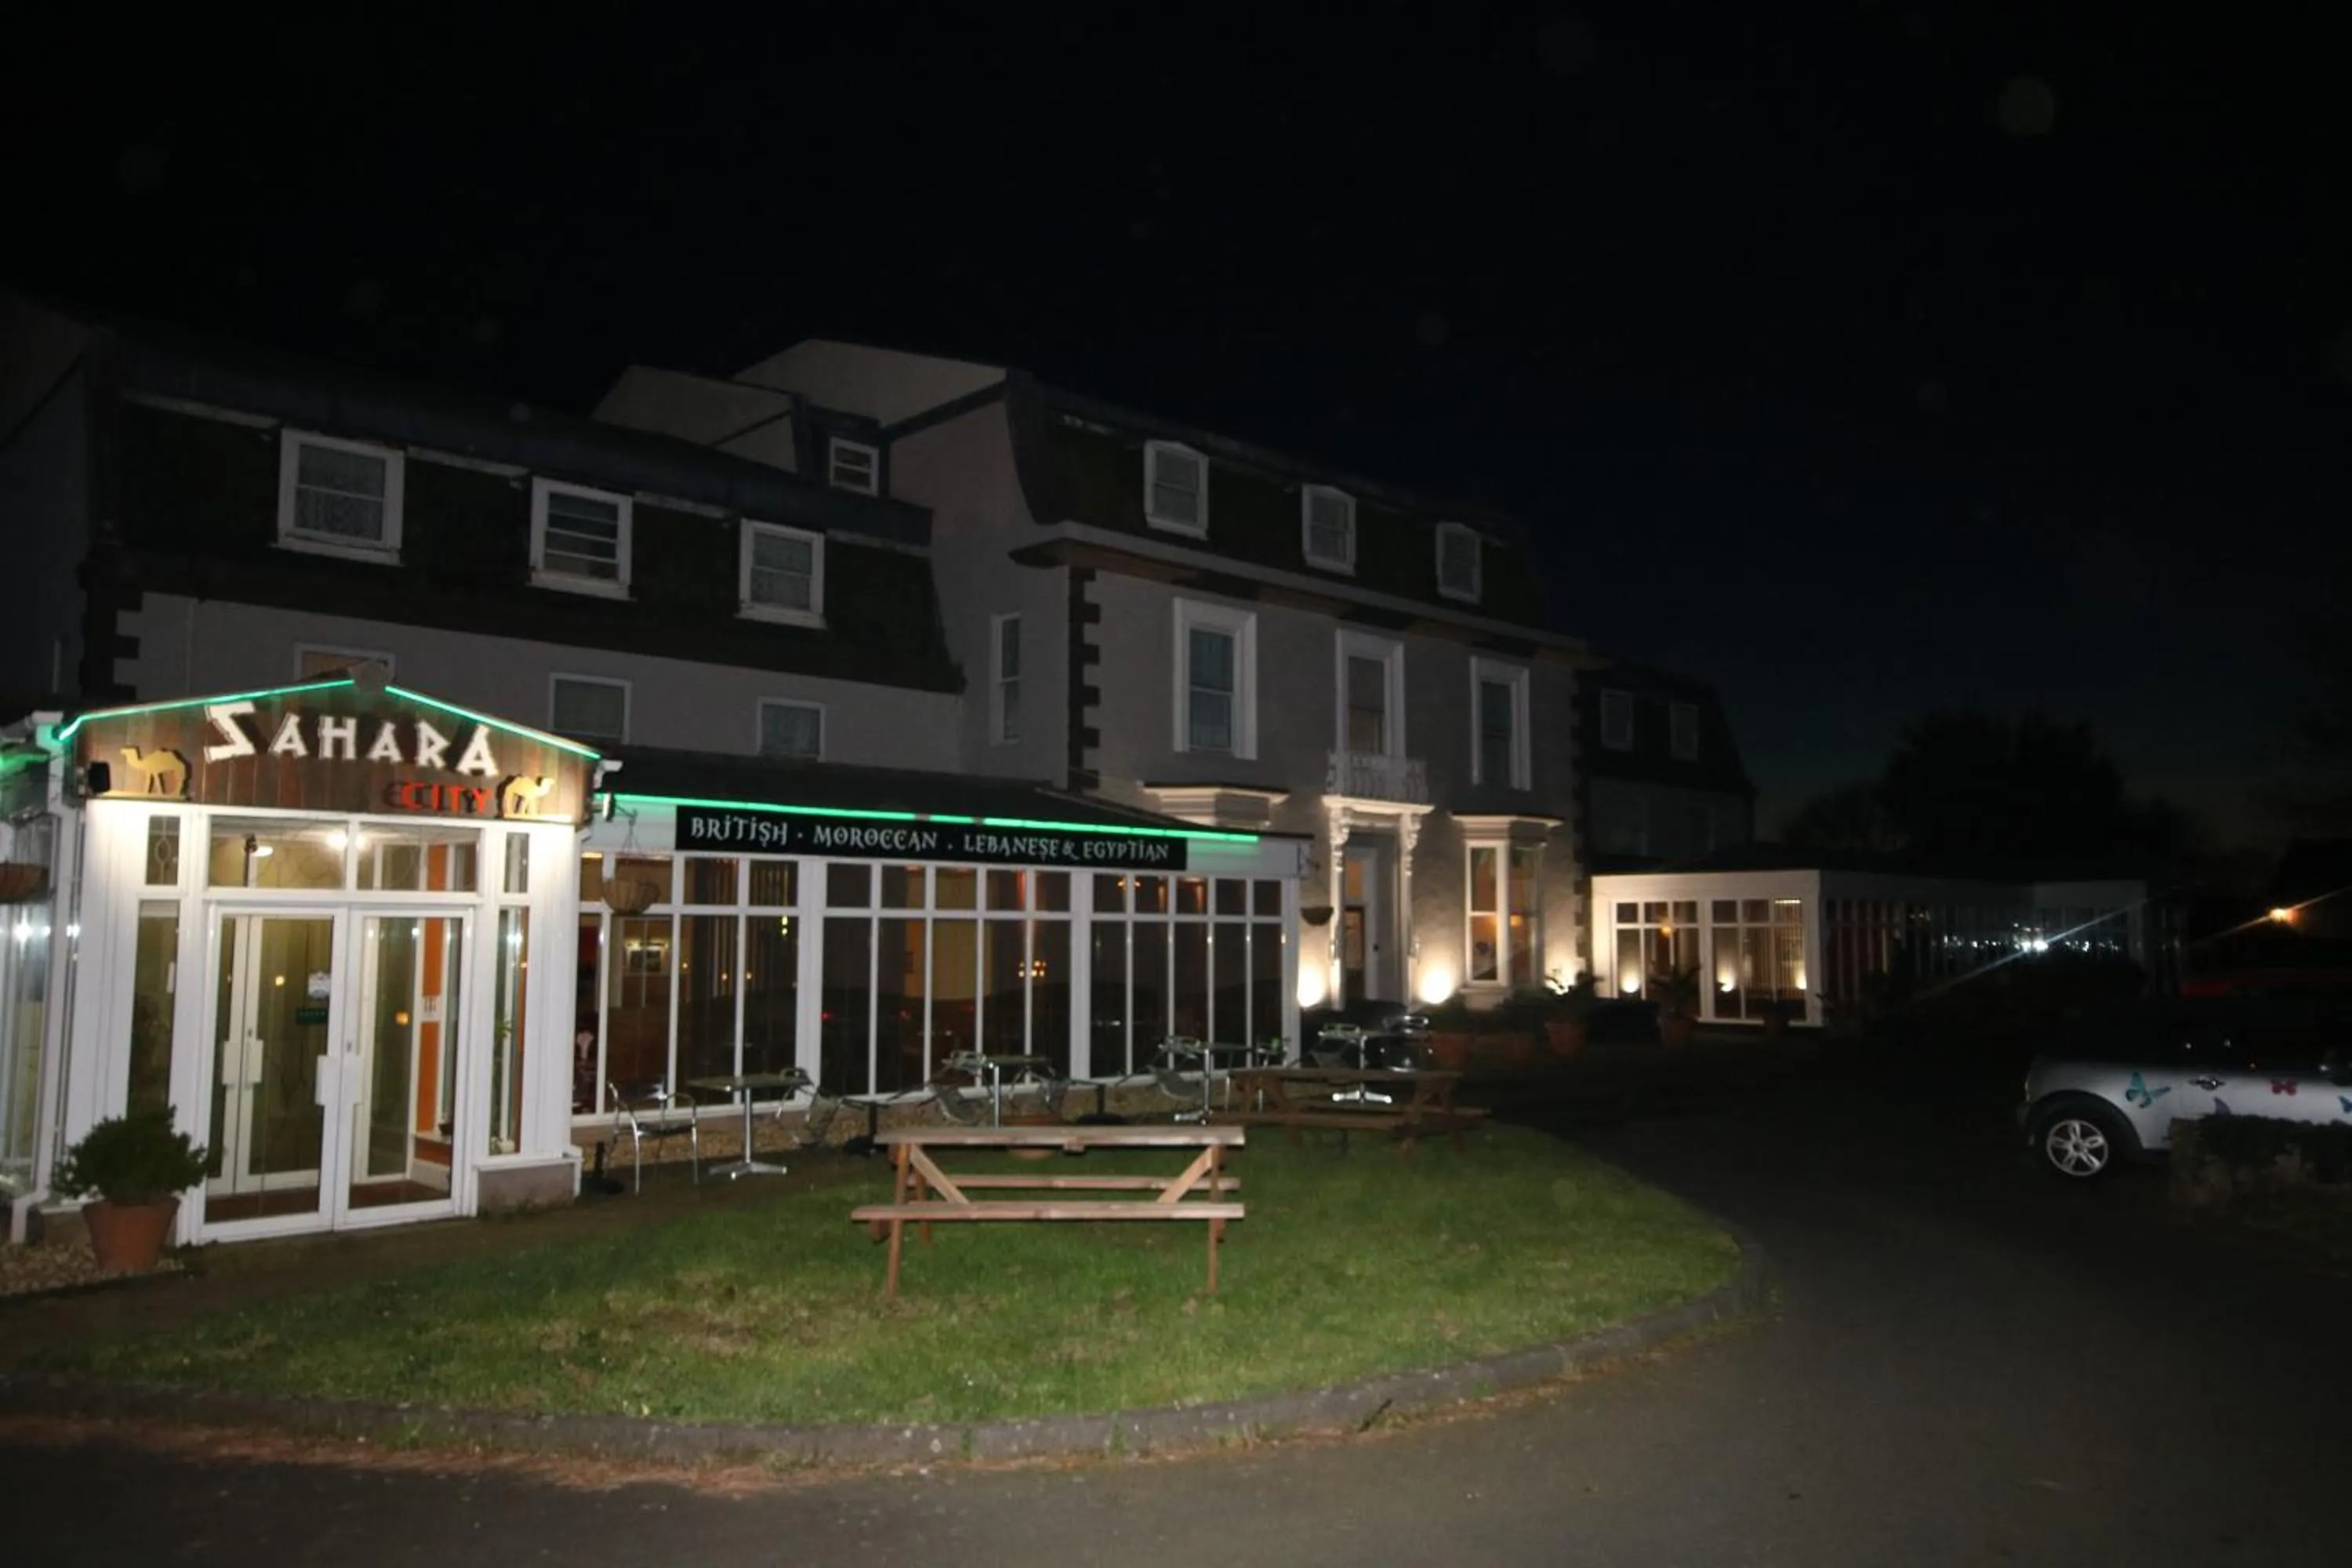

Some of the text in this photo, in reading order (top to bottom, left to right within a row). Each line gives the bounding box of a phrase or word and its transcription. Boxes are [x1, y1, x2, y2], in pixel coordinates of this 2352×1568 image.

[204, 701, 499, 777] SAHARA
[401, 780, 492, 815] CITY
[813, 824, 937, 851] MOROCCAN
[963, 834, 1062, 860] LEBANESE
[1082, 838, 1169, 861] EGYPTIAN
